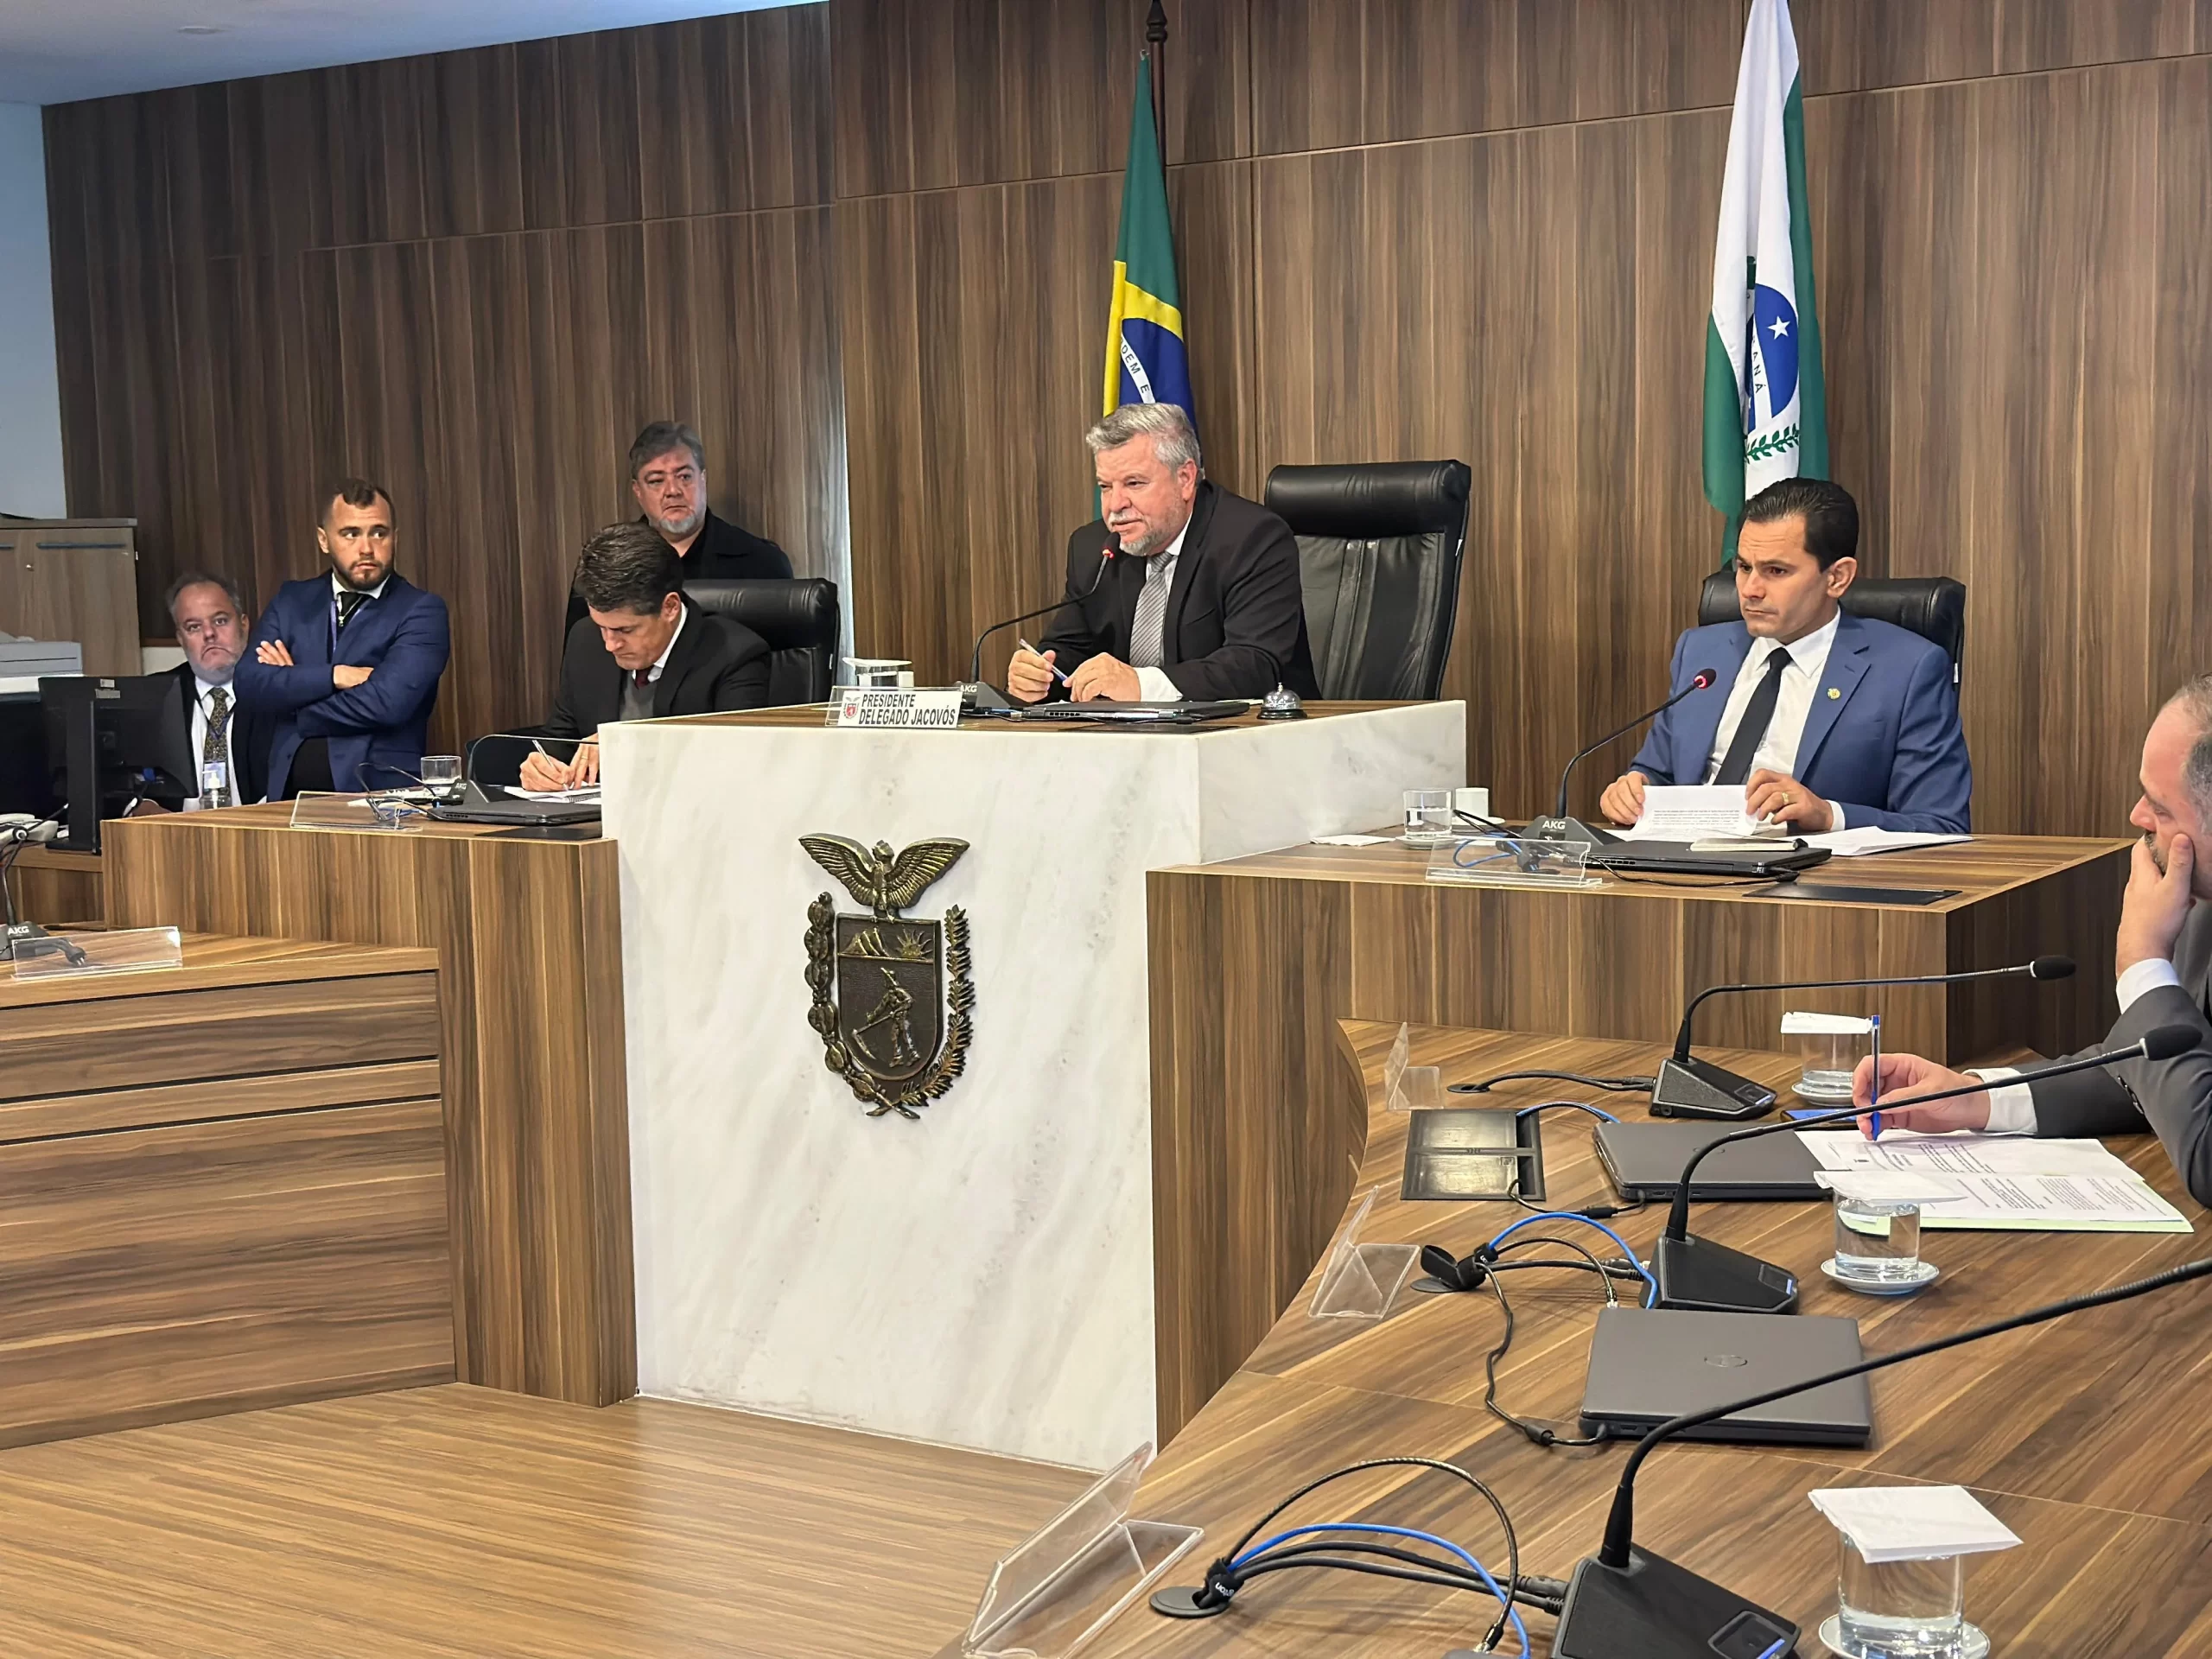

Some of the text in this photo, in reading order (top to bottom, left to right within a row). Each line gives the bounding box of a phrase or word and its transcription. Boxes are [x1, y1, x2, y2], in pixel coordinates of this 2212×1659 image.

[1752, 335, 1767, 394] ANÁ
[1141, 385, 1150, 394] E
[960, 684, 977, 693] AKG
[861, 694, 916, 708] PRESIDENTE
[858, 705, 956, 725] DELEGADO JACOVÓS
[1541, 820, 1566, 830] AKG
[7, 925, 30, 936] AKG
